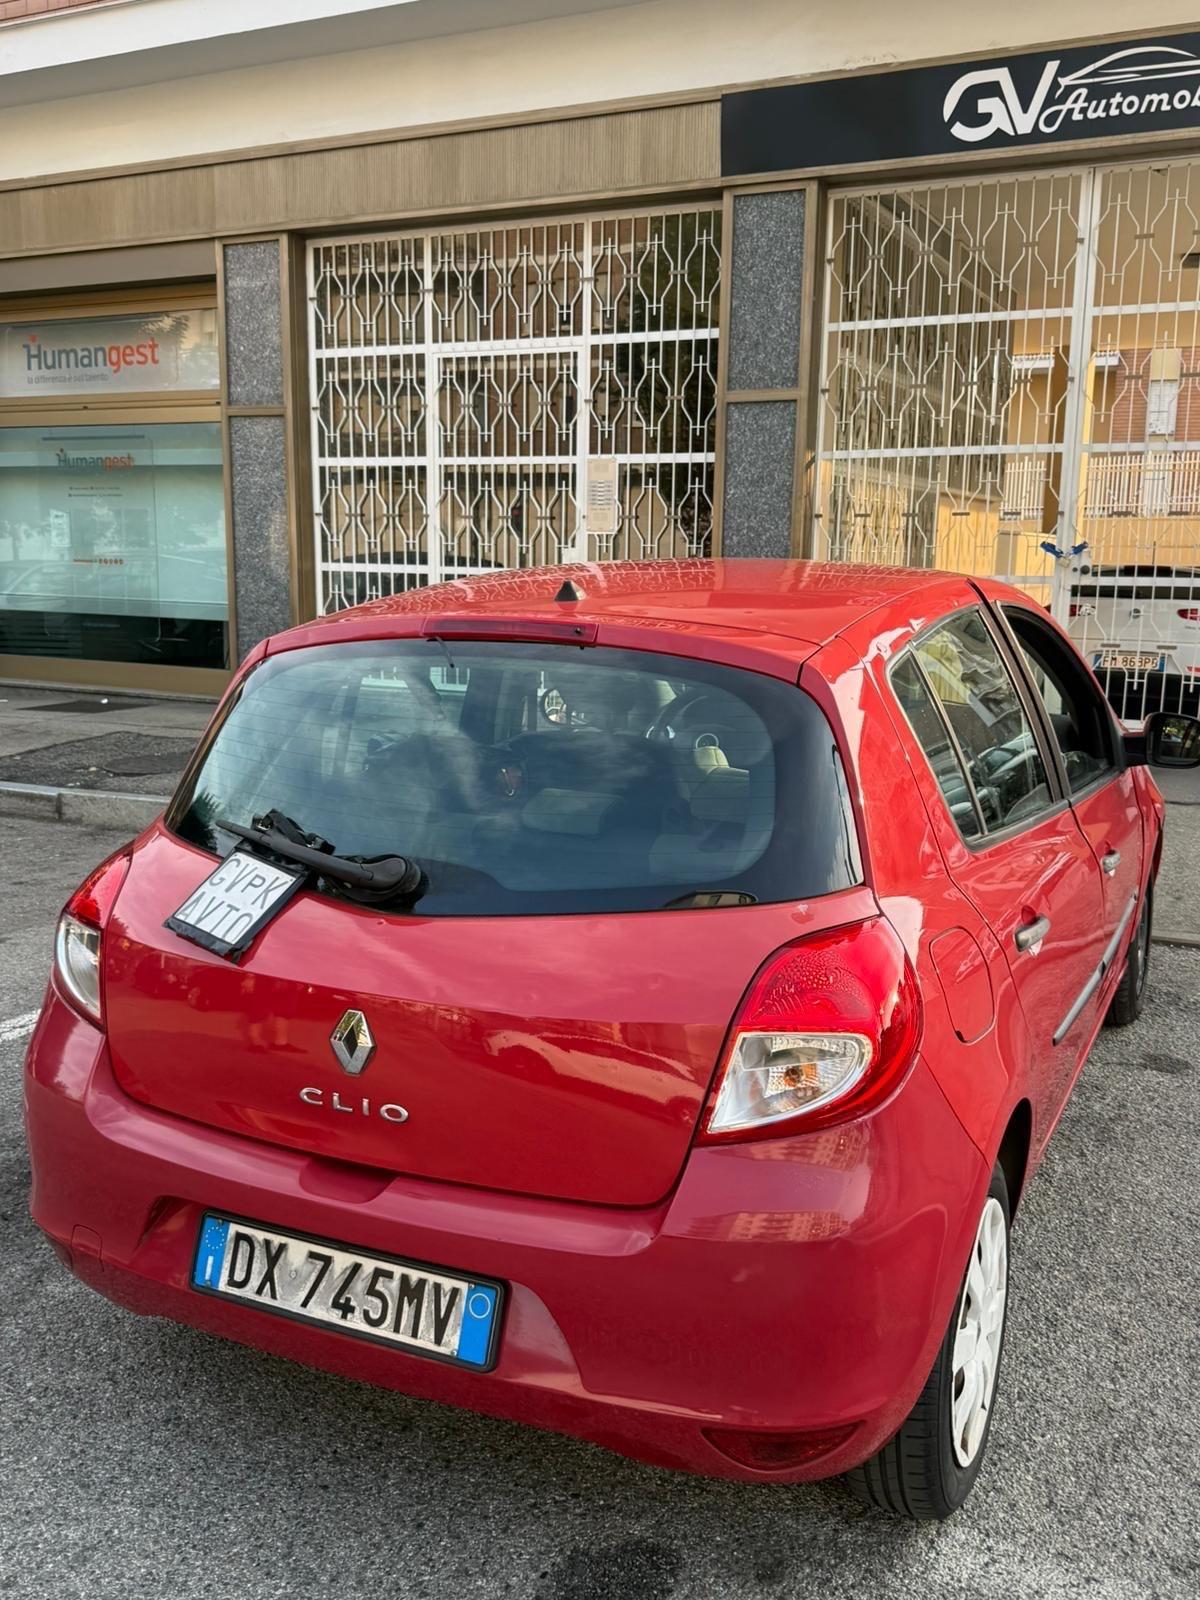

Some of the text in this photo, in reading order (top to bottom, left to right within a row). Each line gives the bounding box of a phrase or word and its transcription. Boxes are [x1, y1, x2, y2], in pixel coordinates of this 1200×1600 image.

[943, 60, 1061, 142] GV
[22, 334, 159, 374] Humangest
[56, 447, 135, 472] Humangest
[299, 1087, 409, 1123] CLIO
[226, 1231, 288, 1300] DX
[299, 1250, 463, 1346] 745MV
